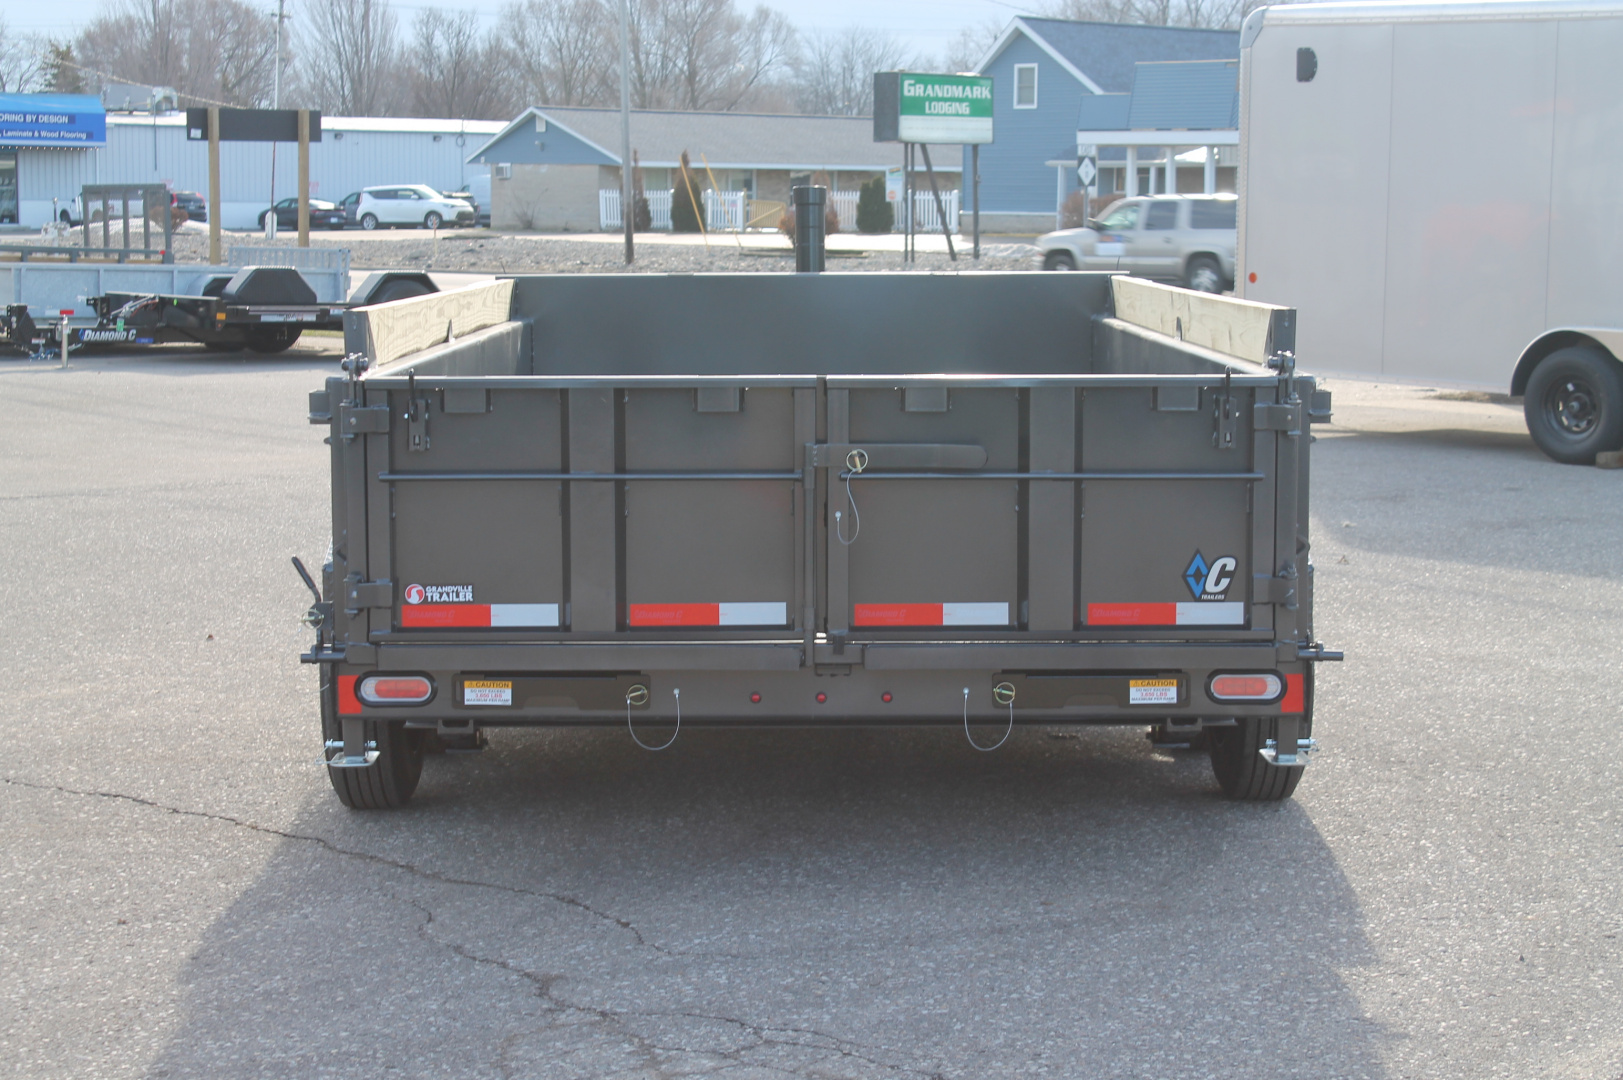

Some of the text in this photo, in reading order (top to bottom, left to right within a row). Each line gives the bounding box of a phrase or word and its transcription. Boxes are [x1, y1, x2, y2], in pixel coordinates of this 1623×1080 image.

[903, 80, 992, 99] GRANDMARK
[925, 101, 970, 115] LODGING
[26, 114, 37, 123] BY
[38, 114, 69, 124] DESIGN
[3, 129, 32, 138] Laminate
[34, 130, 39, 138] &
[40, 130, 59, 138] Wood
[60, 131, 87, 140] Flooring
[84, 329, 137, 342] DIAMOND C
[1205, 556, 1236, 594] C
[426, 592, 473, 602] TRAILER
